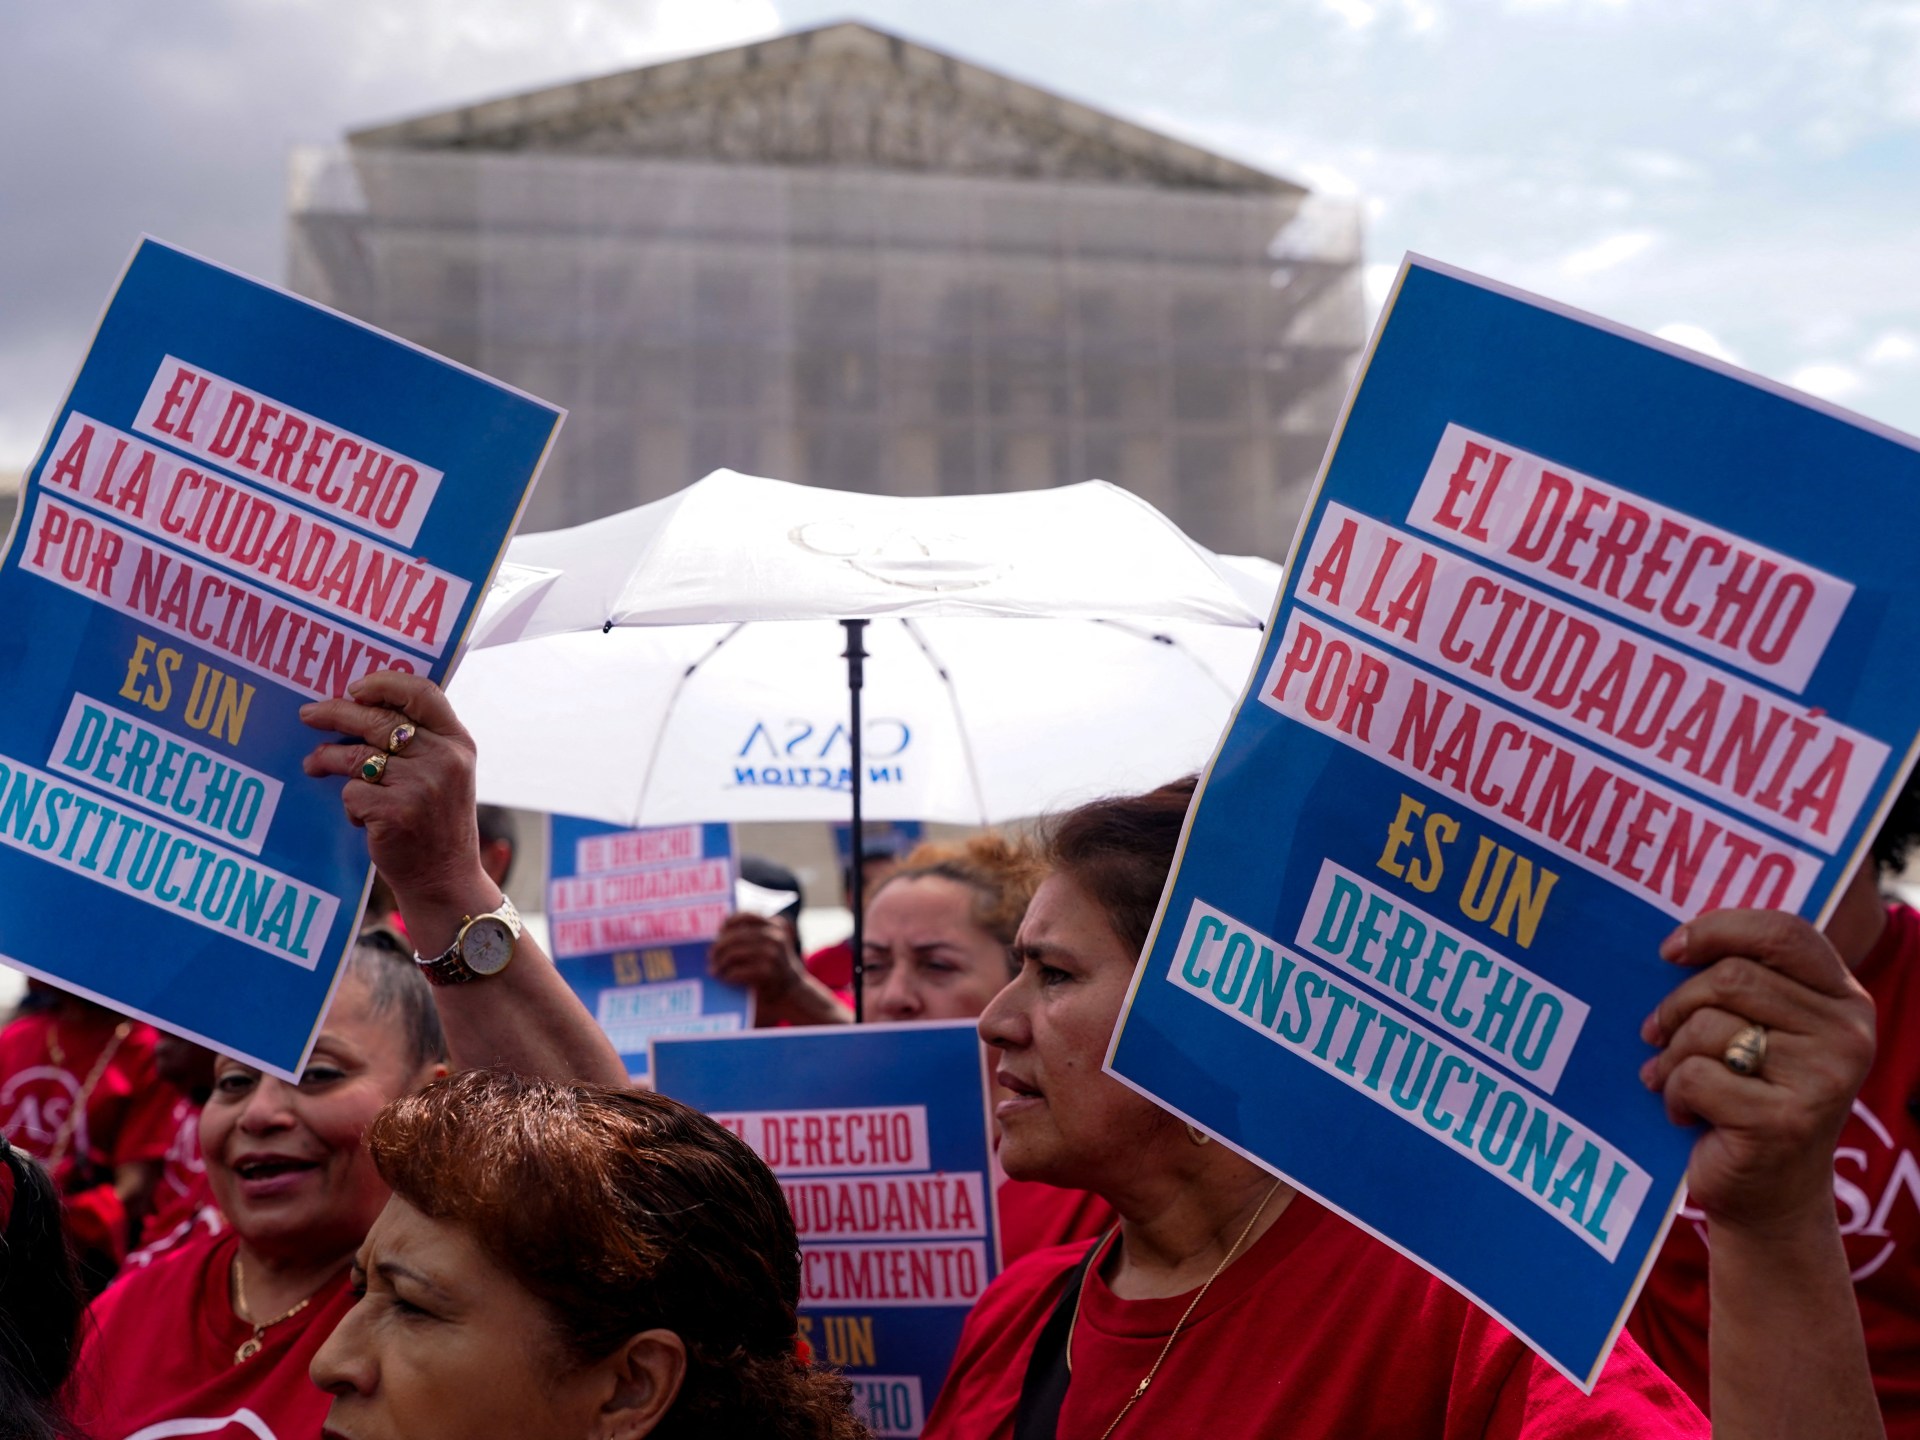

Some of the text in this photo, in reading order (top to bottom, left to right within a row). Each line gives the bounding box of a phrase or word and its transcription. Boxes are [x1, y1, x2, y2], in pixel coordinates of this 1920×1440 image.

[51, 424, 448, 646] A LA CIUDADANÍA
[152, 367, 419, 530] EL DERECHO
[32, 503, 415, 704] POR NACIMIENT
[1432, 440, 1816, 666] EL DERECHO
[118, 635, 256, 747] ES UN
[1307, 518, 1858, 837] A LA CIUDADANÍA
[65, 704, 266, 841] DERECHO
[1271, 622, 1797, 917] POR NACIMIENTO
[0, 762, 321, 959] NSTITUCIONAL
[1376, 793, 1559, 949] ES UN
[1312, 873, 1563, 1073] DERECHO
[761, 1112, 913, 1168] DERECHO
[1181, 914, 1631, 1246] CONSTITUCIONAL
[783, 1171, 976, 1234] UDADANÍA
[799, 1247, 978, 1301] CIMIENTO
[823, 1316, 877, 1367] UN
